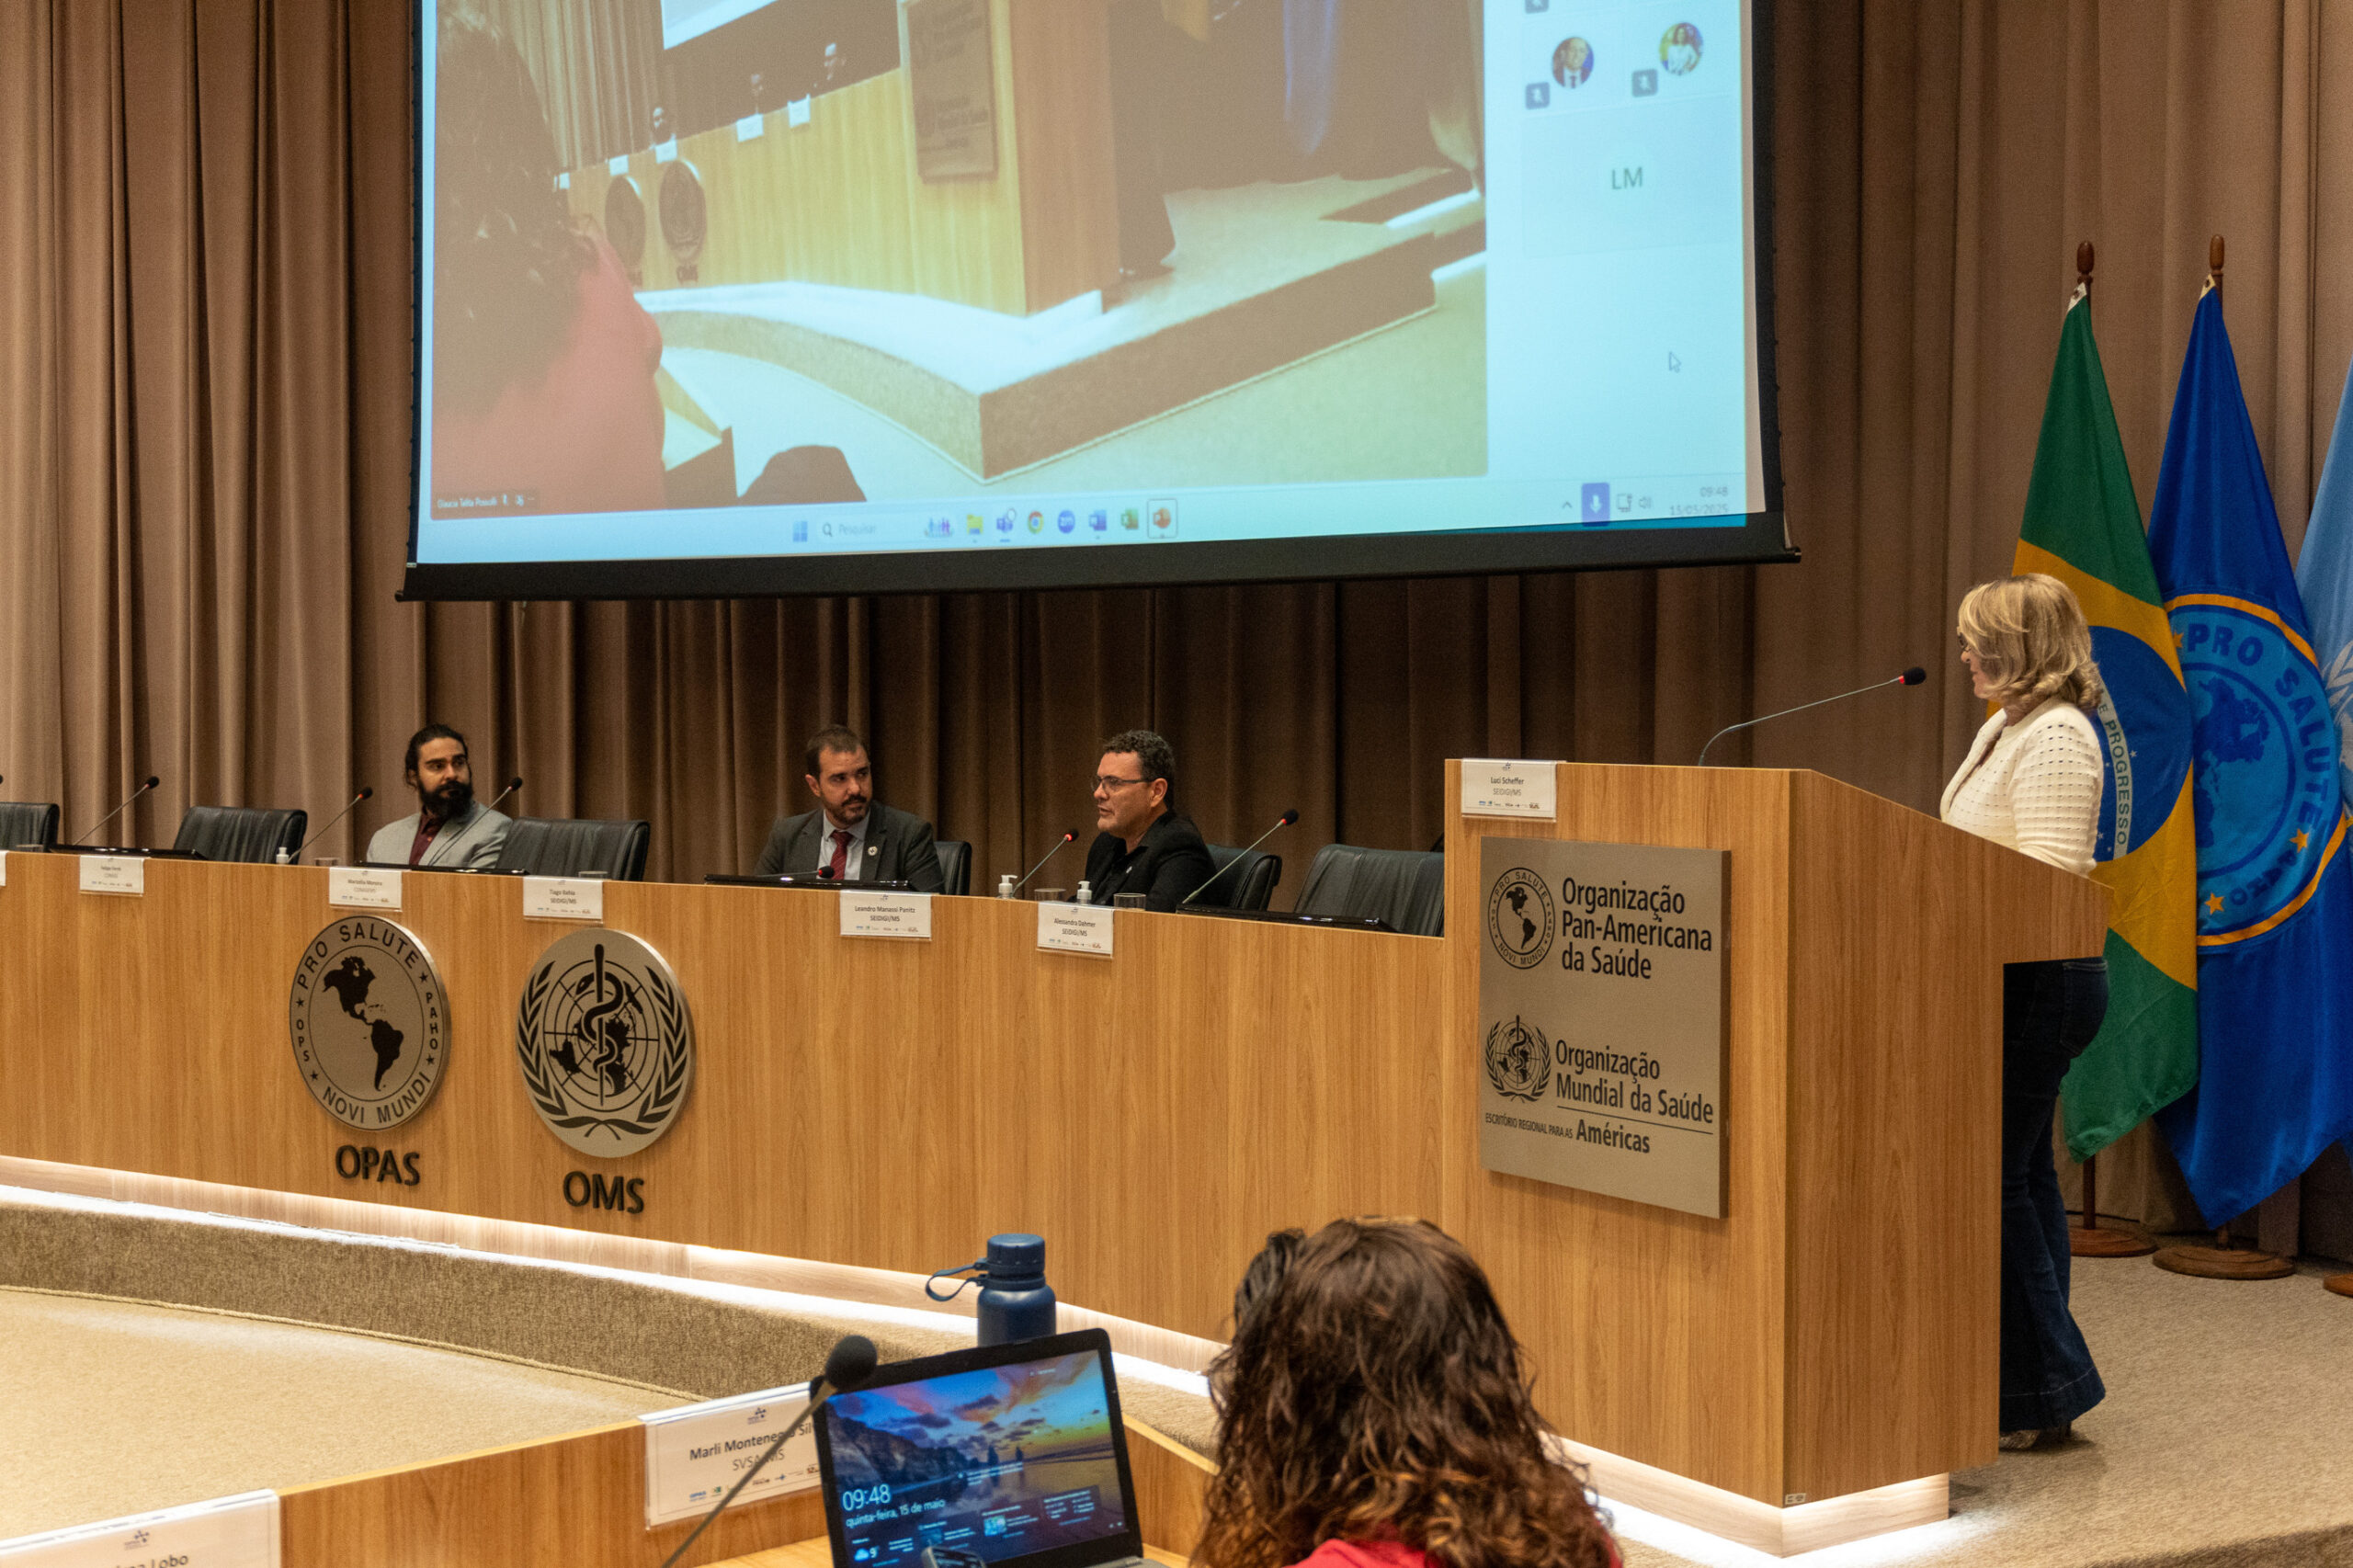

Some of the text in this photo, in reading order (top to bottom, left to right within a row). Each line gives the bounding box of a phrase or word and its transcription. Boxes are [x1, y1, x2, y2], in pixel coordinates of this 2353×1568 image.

[1611, 167, 1643, 190] LM
[2188, 622, 2331, 825] PRO SALUTE
[2104, 719, 2131, 846] PROGRESSO
[1495, 871, 1548, 900] PRO SALUTE
[1563, 877, 1685, 921] Organização
[2231, 849, 2298, 906] PAHO
[1563, 910, 1711, 951] Pan-Americana
[298, 922, 420, 990] PRO SALUTE
[1498, 942, 1546, 965] NOVI MUNDI
[1563, 942, 1652, 980] da Saúde
[296, 1019, 310, 1062] OPS
[426, 992, 438, 1051] PAHO
[1556, 1040, 1660, 1084] Organização
[323, 1073, 430, 1123] NOVI MUNDI
[1556, 1073, 1713, 1123] Mundial da Saúde
[1485, 1112, 1650, 1153] ESCRITÓRIO REGIONAL PARA AS Américas
[335, 1144, 421, 1187] OPAS
[563, 1171, 645, 1214] OMS
[689, 1422, 813, 1461] Marli Montenego Sil
[733, 1449, 785, 1471] SVSAMS
[842, 1483, 892, 1511] 09:48
[900, 1504, 909, 1516] 15
[911, 1502, 923, 1514] de
[924, 1497, 946, 1510] maio
